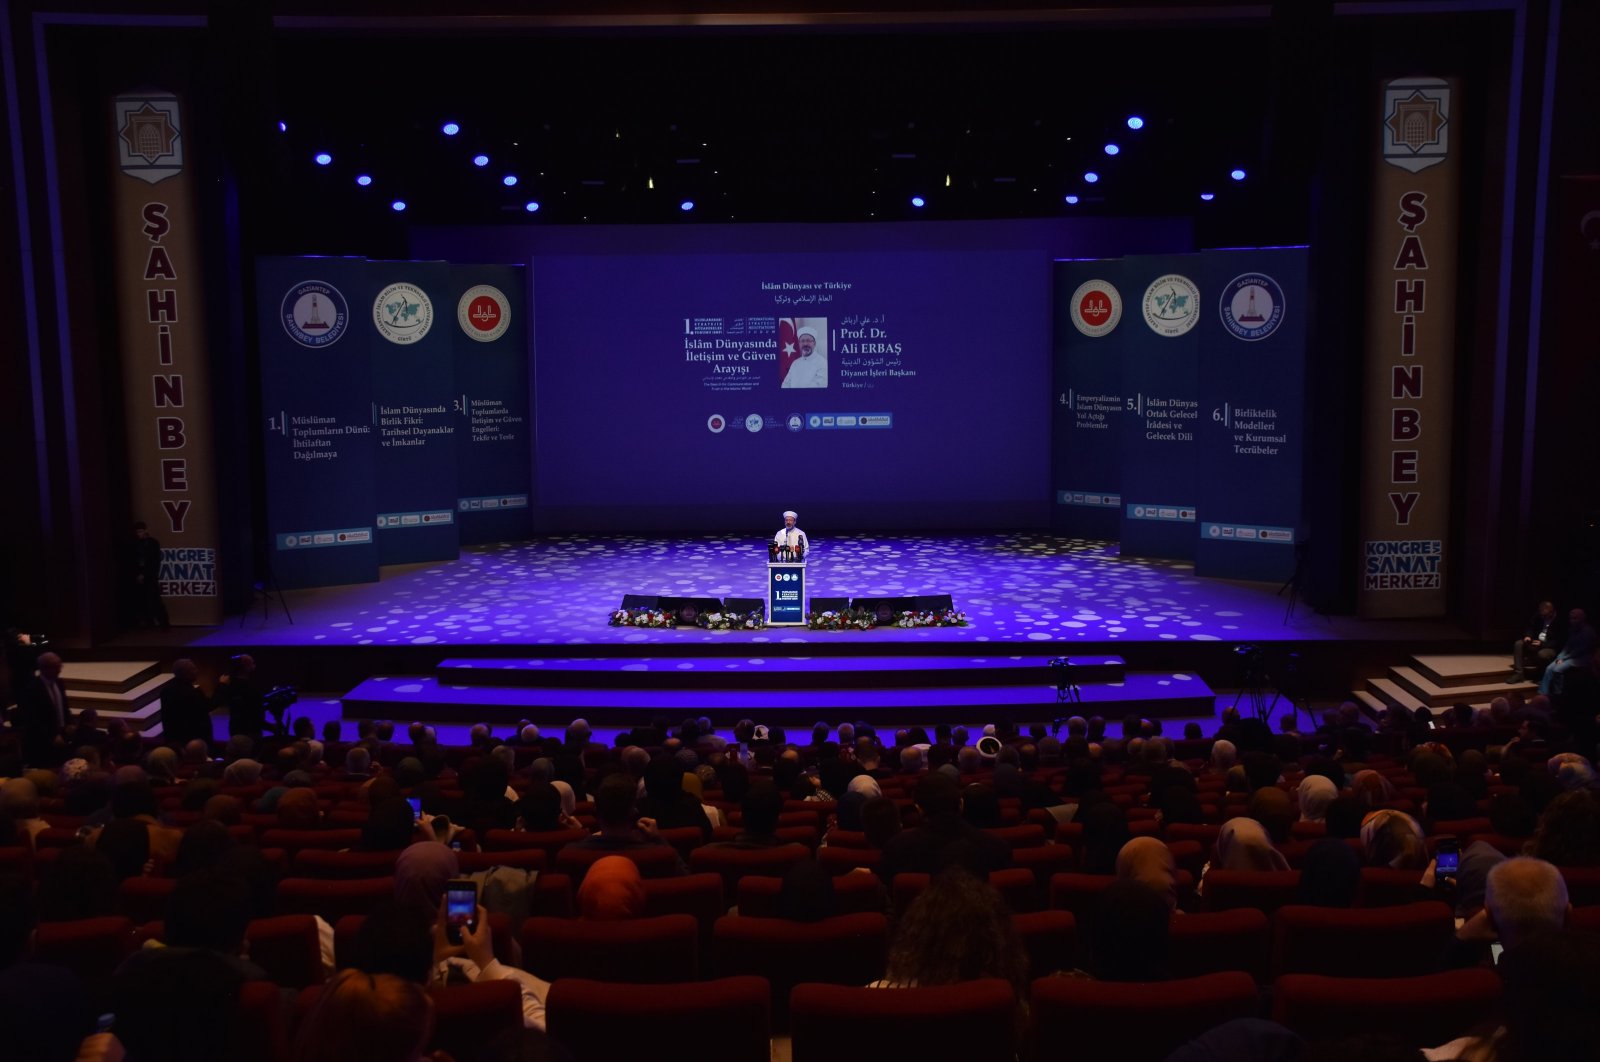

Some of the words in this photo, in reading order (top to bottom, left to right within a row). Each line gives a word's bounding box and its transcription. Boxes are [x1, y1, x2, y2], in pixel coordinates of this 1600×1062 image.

[298, 285, 330, 295] GAZİANTEP
[761, 281, 781, 290] İslâm
[782, 282, 812, 292] Dünyası
[823, 281, 852, 291] Türkiye
[684, 318, 694, 335] 1.
[840, 327, 867, 339] Prof.
[870, 328, 887, 339] Dr.
[684, 337, 713, 349] İslâm
[715, 338, 777, 351] Dünyasında
[841, 343, 858, 354] Ali
[861, 342, 902, 356] ERBAŞ
[685, 349, 725, 364] İletişim
[742, 351, 777, 361] Güven
[1388, 191, 1429, 525] ŞAHİNBEY
[142, 203, 191, 533] ŞAHİNBEY
[712, 364, 750, 376] Arayışı
[841, 369, 869, 379] Diyanet
[869, 368, 888, 378] İşleri
[889, 369, 916, 378] Başkanı
[471, 399, 503, 407] Müslüman
[1059, 393, 1069, 405] 4.
[1126, 398, 1137, 411] 5.
[1146, 396, 1167, 407] İslâm
[380, 405, 401, 415] İslam
[402, 405, 446, 415] Dünyasında
[453, 399, 463, 412] 3.
[472, 407, 509, 416] Toplumlarda
[1076, 411, 1087, 419] Yol
[1146, 409, 1168, 418] Ortak
[1212, 408, 1224, 422] 6.
[1234, 408, 1277, 418] Birliktelik
[268, 416, 281, 431] 1.
[291, 415, 336, 425] Müslüman
[381, 416, 402, 425] Birlik
[403, 416, 424, 425] Fikri:
[1076, 421, 1108, 429] Problemler
[381, 427, 411, 437] Tarihsel
[412, 426, 455, 437] Dayanaklar
[1234, 421, 1275, 431] Modelleri
[292, 427, 343, 439] Toplumların
[345, 426, 371, 434] Dünü:
[1146, 431, 1176, 440] Gelecek
[1177, 432, 1193, 441] Dili
[293, 437, 331, 448] İhtilaftan
[392, 436, 426, 447] İmkanlar
[1233, 434, 1243, 442] ve
[1245, 434, 1287, 444] Kurumsal
[1233, 444, 1279, 455] Tecrübeler
[294, 450, 338, 461] Dağılmaya
[1366, 542, 1431, 555] KONGRE
[1366, 556, 1440, 573] SANAT
[160, 563, 215, 580] ANAT
[1366, 574, 1439, 589] MERKEZİ
[160, 582, 216, 595] ERKEZİ
